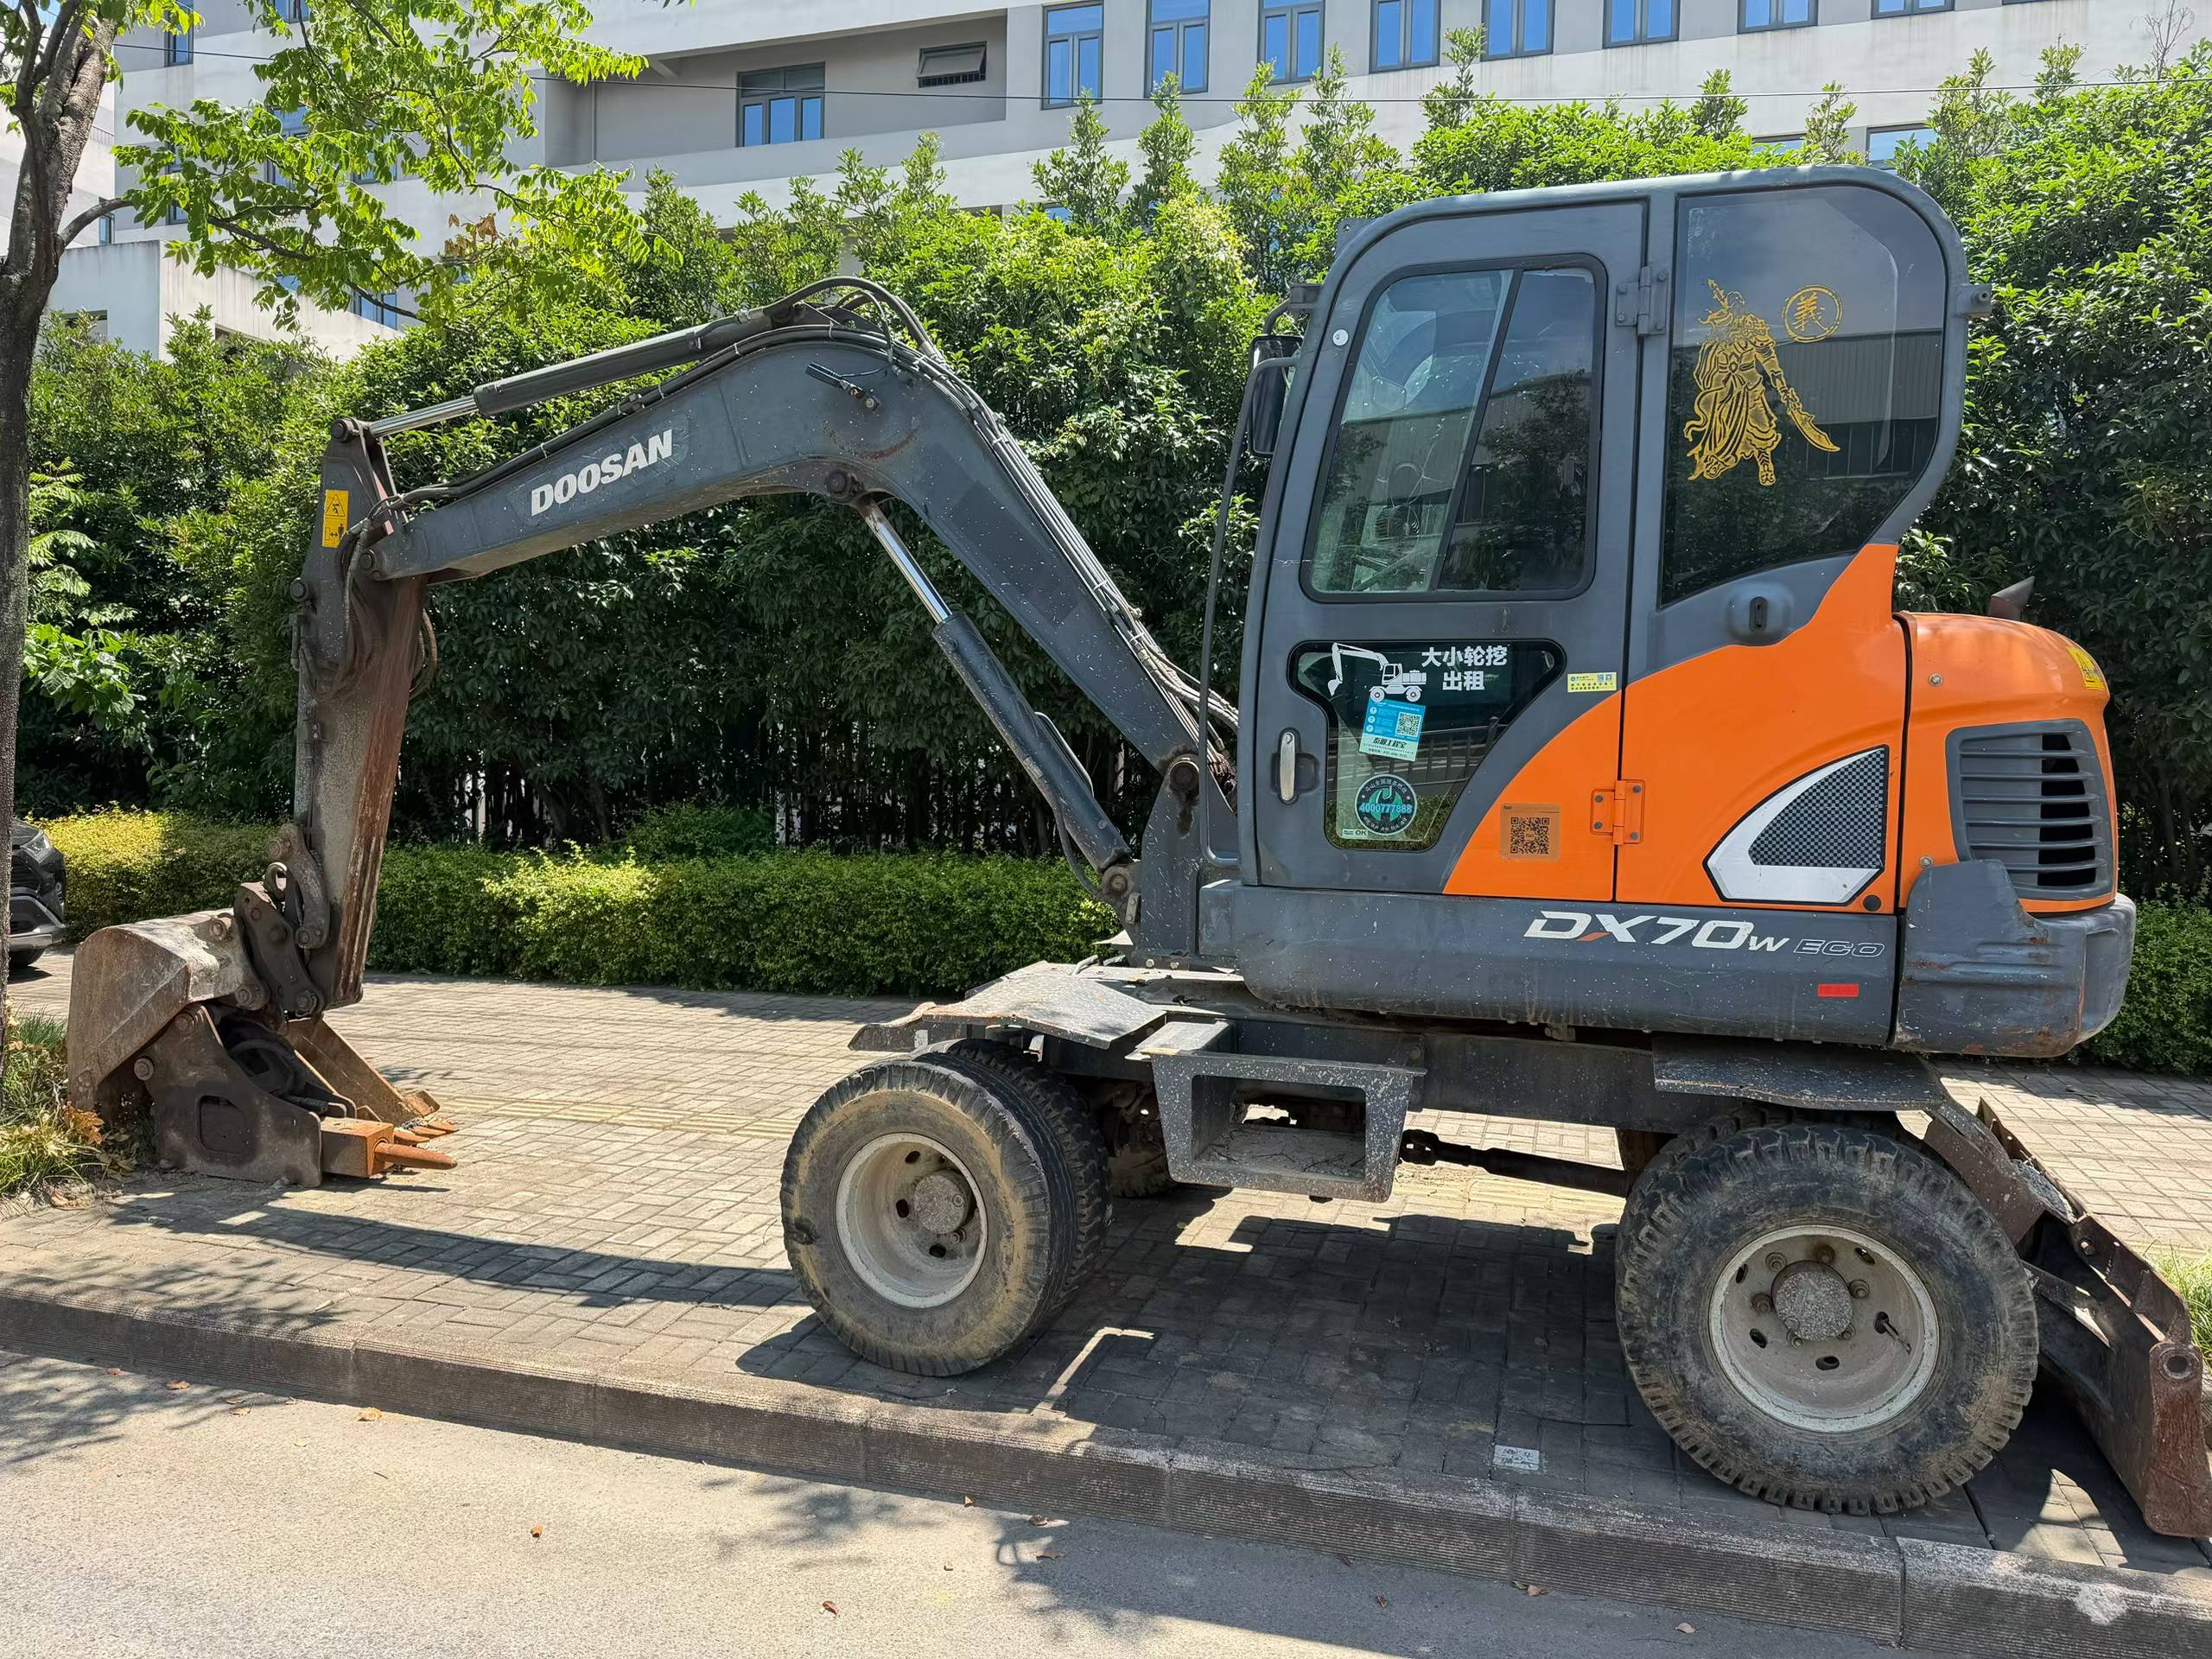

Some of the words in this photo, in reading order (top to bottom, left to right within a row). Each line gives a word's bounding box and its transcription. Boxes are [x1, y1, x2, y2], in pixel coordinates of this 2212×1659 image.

[531, 429, 672, 517] DOOSAN
[1421, 645, 1508, 668] 大小轮挖
[1442, 671, 1484, 690] 出租
[1359, 803, 1413, 814] 4000777888
[1792, 938, 1885, 958] ECO
